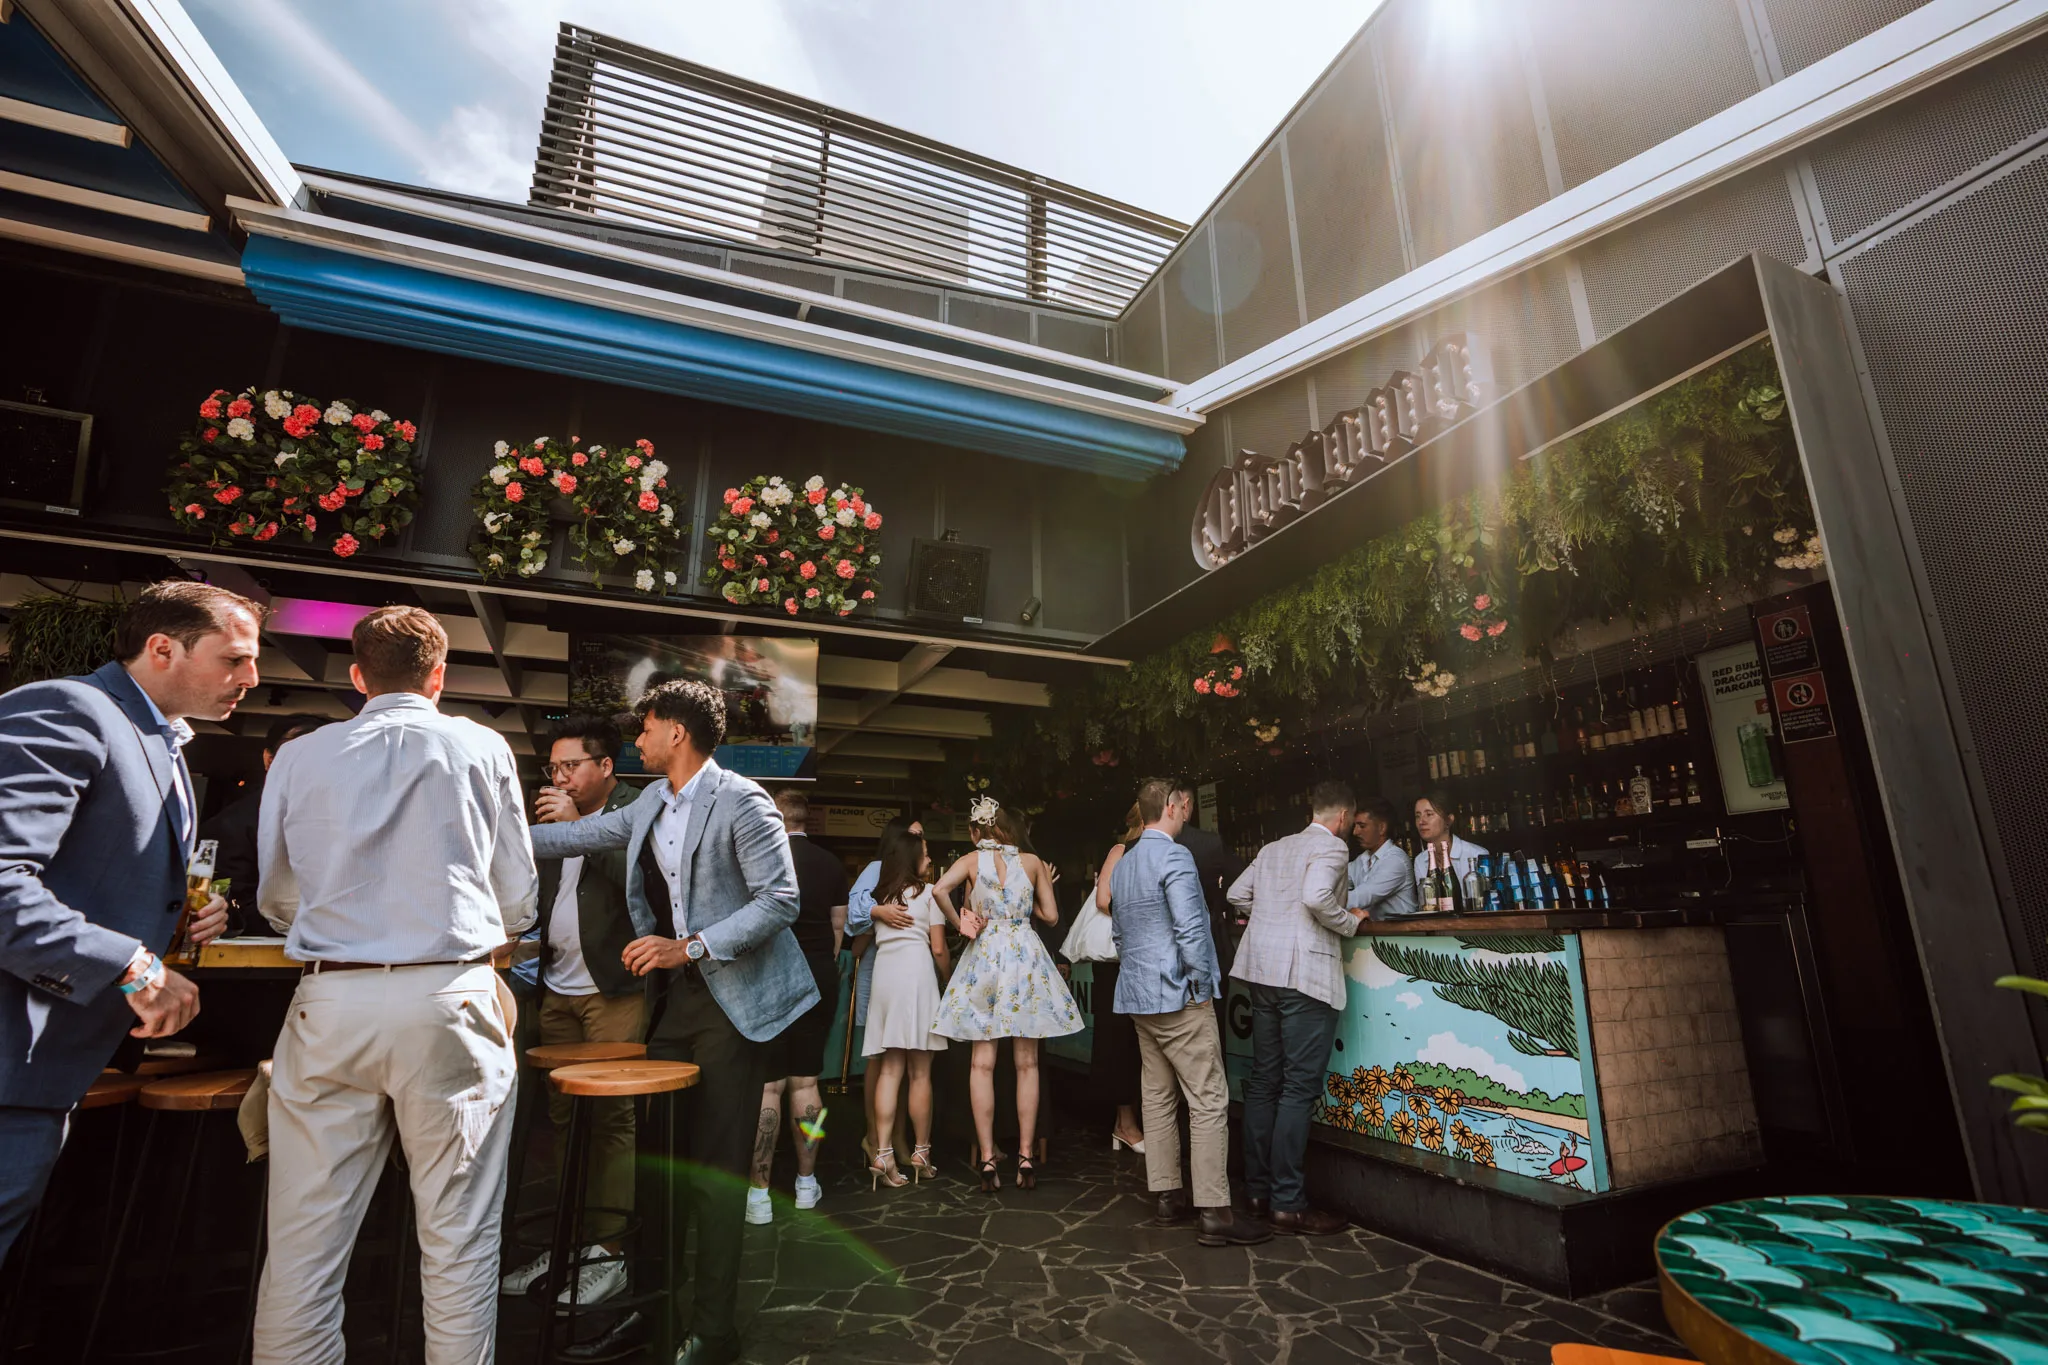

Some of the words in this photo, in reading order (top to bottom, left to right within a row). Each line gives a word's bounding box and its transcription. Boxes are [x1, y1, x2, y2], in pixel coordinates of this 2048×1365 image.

[1712, 666, 1733, 678] RED
[1735, 660, 1761, 672] BULL
[829, 807, 865, 816] NACHOS
